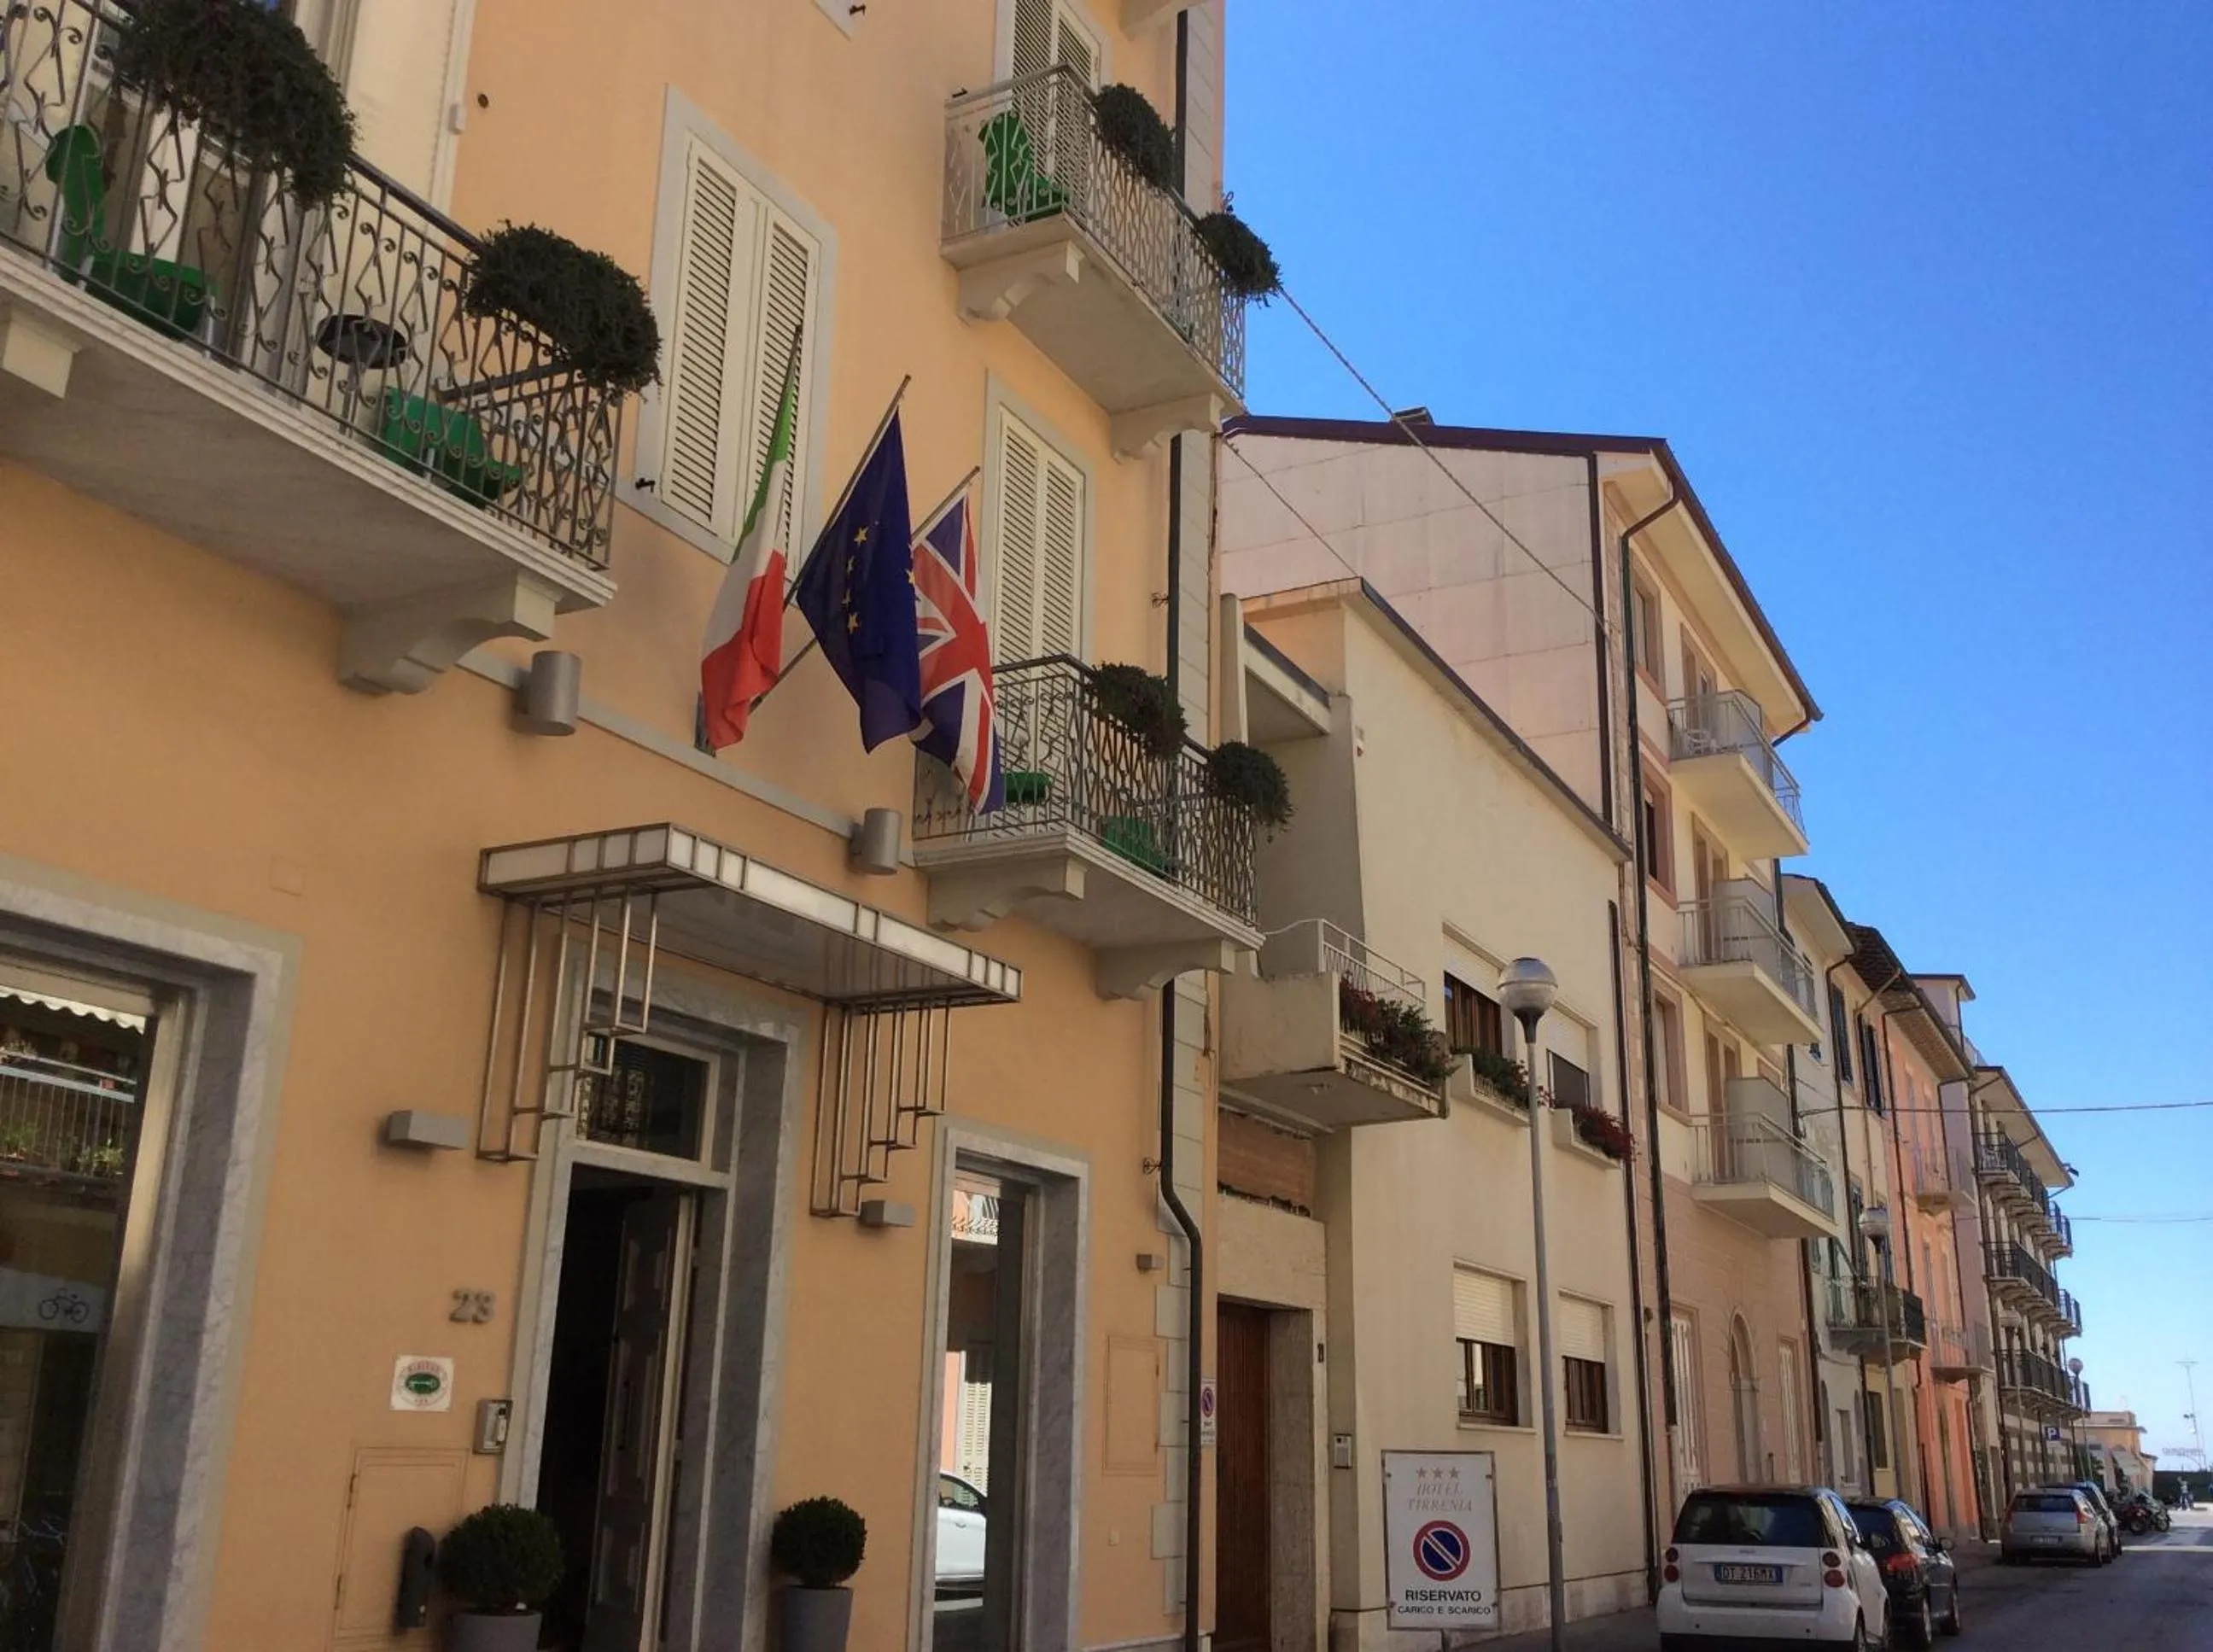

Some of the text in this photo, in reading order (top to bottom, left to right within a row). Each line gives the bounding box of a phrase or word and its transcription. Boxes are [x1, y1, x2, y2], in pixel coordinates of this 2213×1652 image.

[449, 1288, 496, 1324] 28
[2047, 1428, 2056, 1440] P
[1405, 1589, 1481, 1602] RISERVATO
[1398, 1605, 1491, 1615] CARICO E SCARICO
